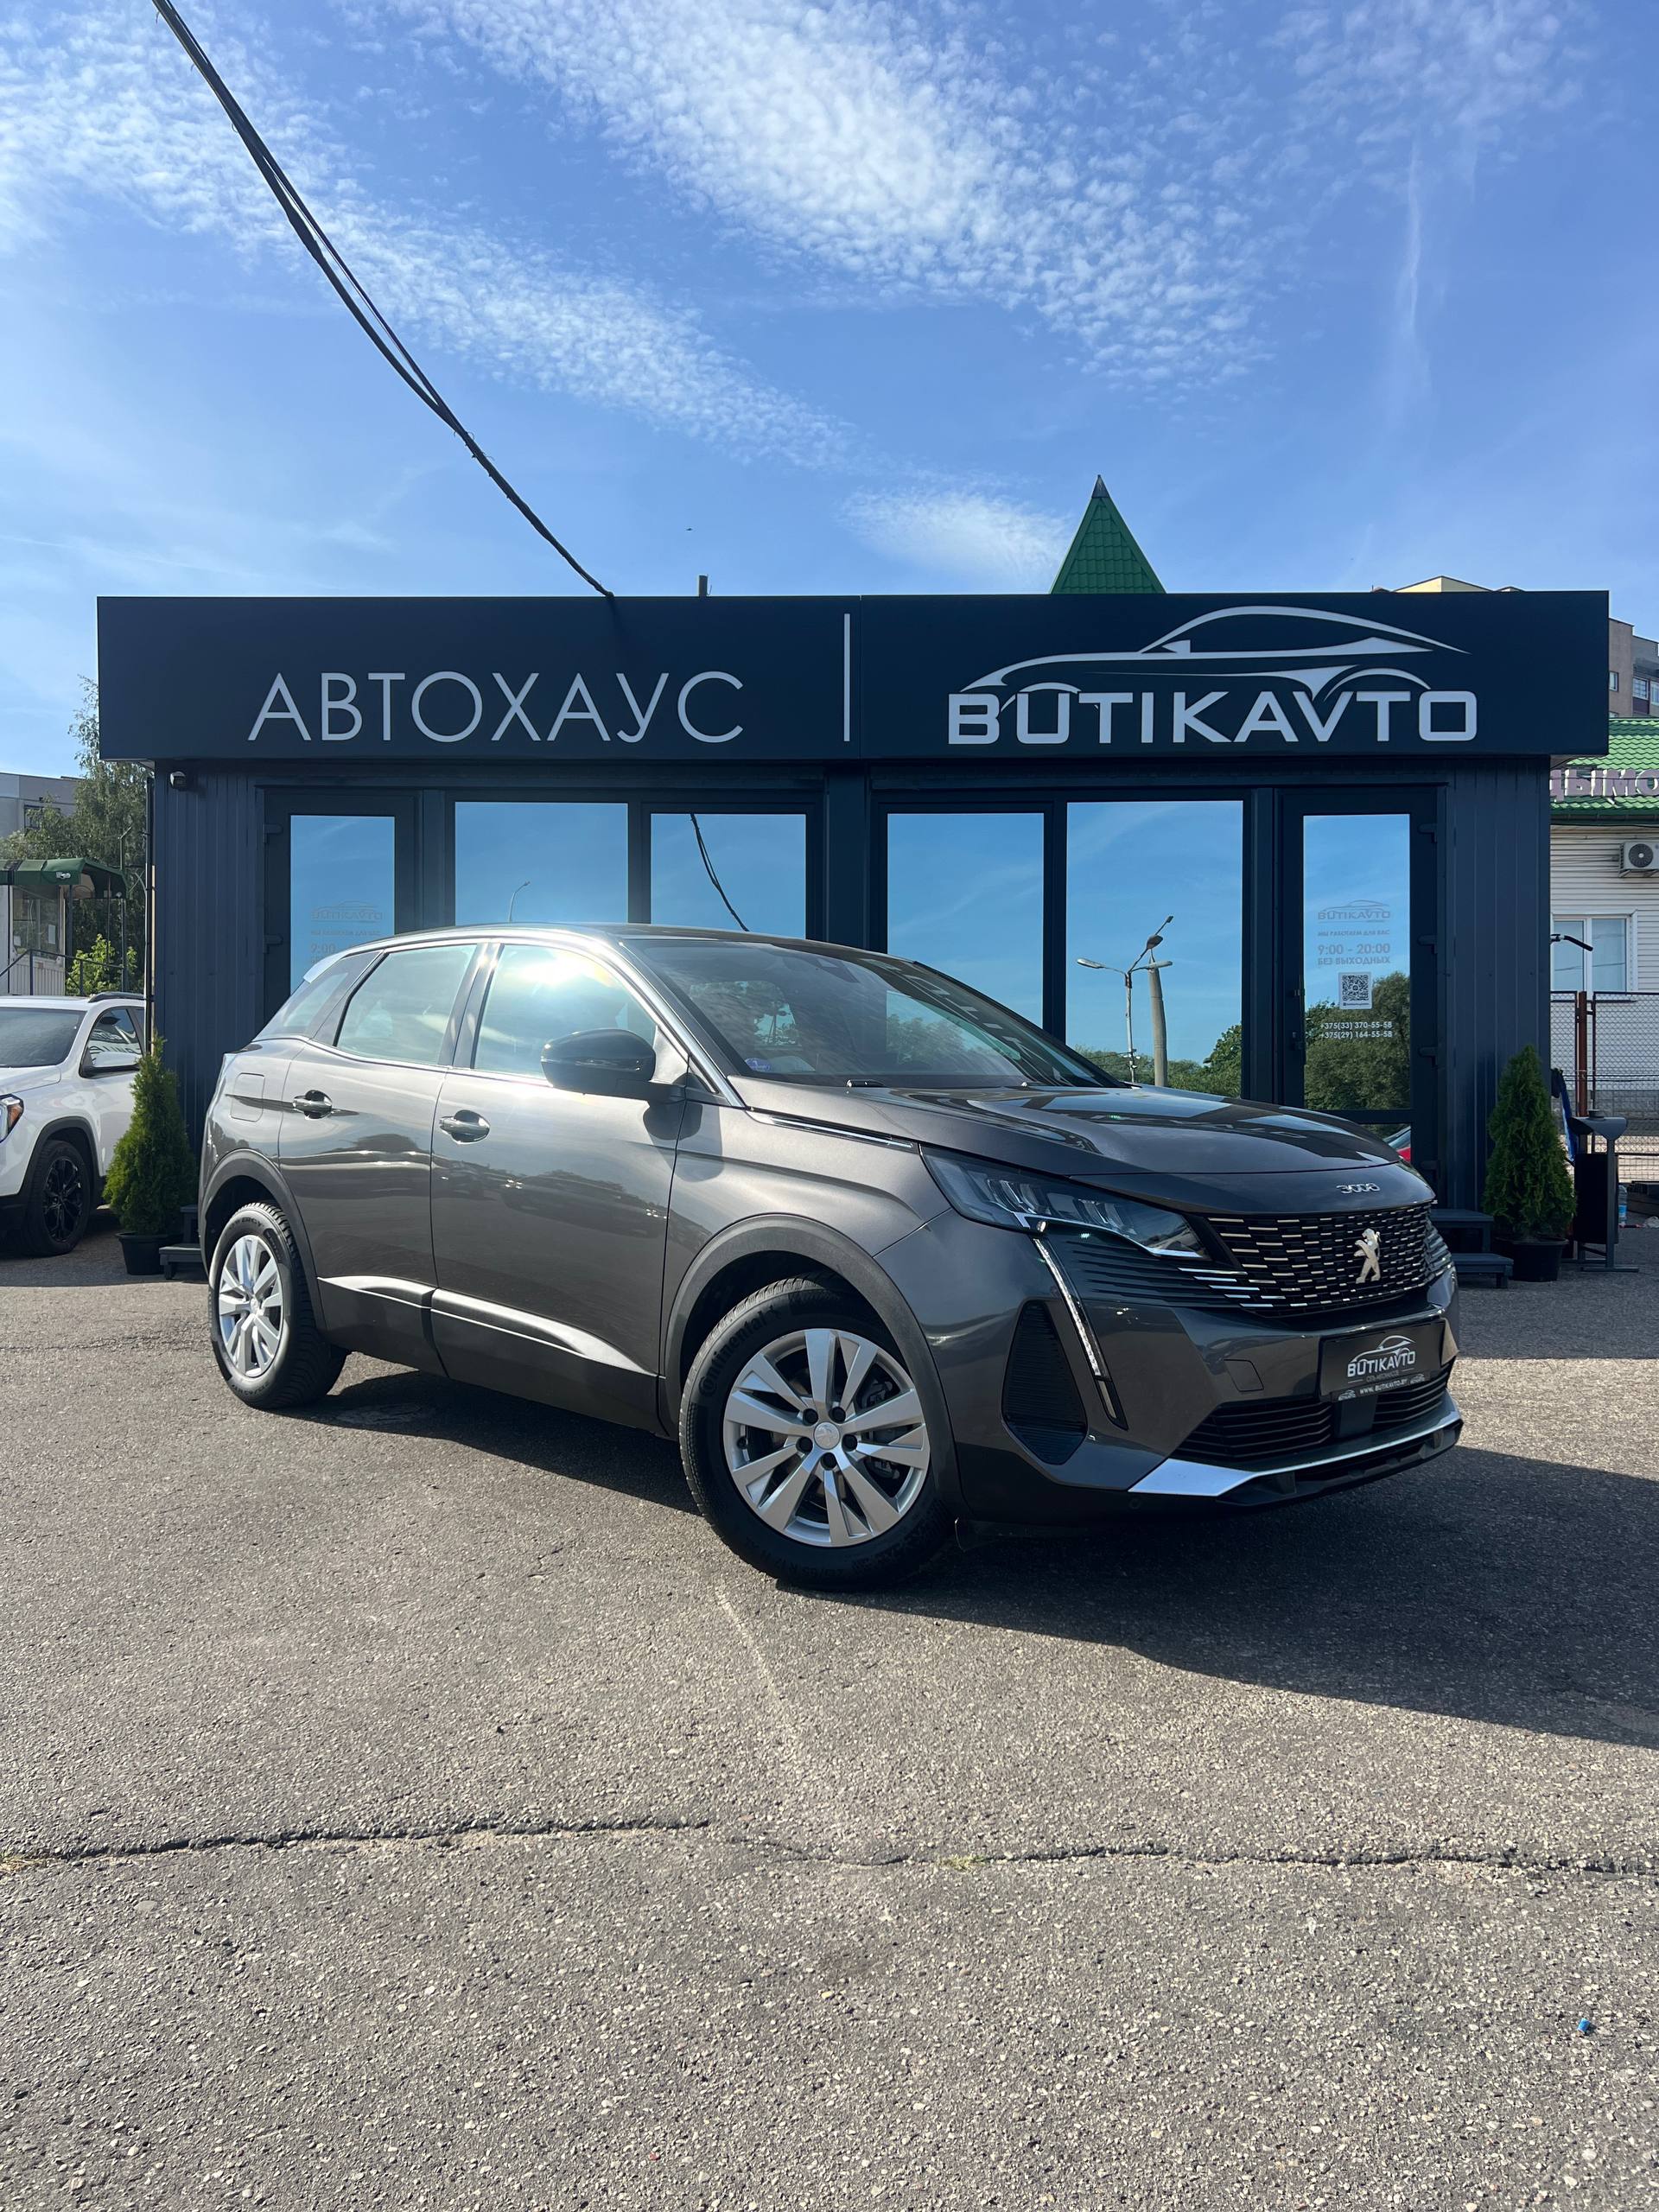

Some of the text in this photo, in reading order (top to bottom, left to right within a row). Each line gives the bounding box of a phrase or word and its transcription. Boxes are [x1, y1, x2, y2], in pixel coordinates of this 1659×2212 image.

[248, 671, 743, 743] АВТОХАУС
[948, 690, 1478, 745] BUTIKAVTO
[1318, 911, 1390, 920] BUTIKAVTO
[1318, 944, 1344, 955] 9:00
[1357, 943, 1390, 954] 20:00
[1318, 956, 1390, 965] БЕЗ ВЫХОДНЫХ
[1336, 1183, 1381, 1194] 3008
[698, 1311, 767, 1397] Continental
[1347, 1351, 1415, 1378] BUTIKAVTO
